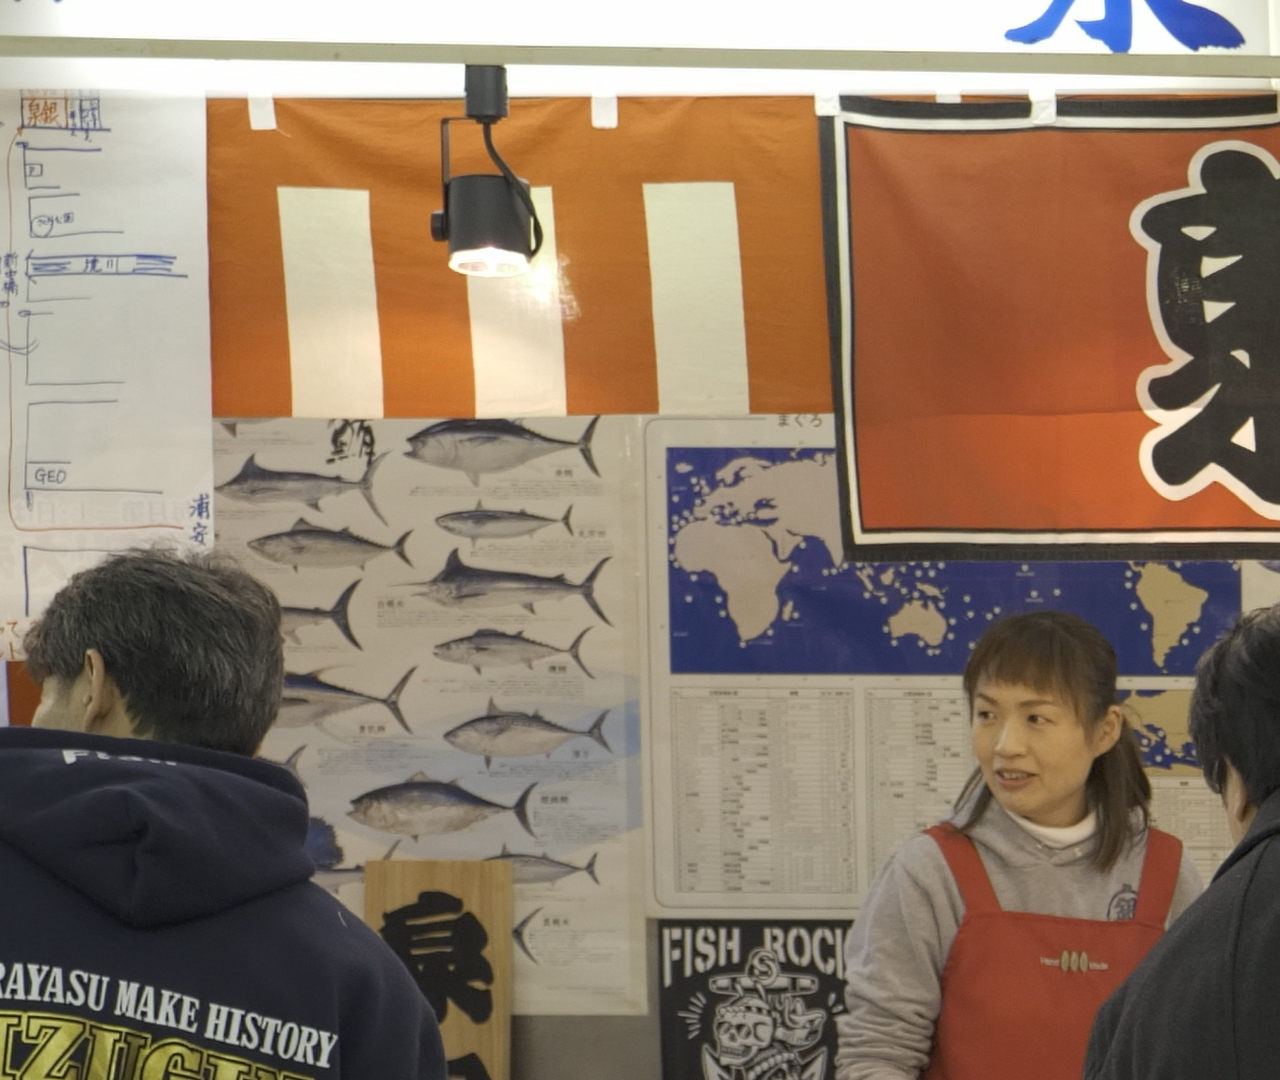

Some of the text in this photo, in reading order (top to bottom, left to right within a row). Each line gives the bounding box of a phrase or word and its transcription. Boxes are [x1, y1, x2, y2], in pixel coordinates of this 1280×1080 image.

[35, 468, 67, 485] GEO
[662, 926, 740, 989] FISH
[114, 979, 200, 1034] MAKE
[204, 1002, 338, 1069] HISTORY
